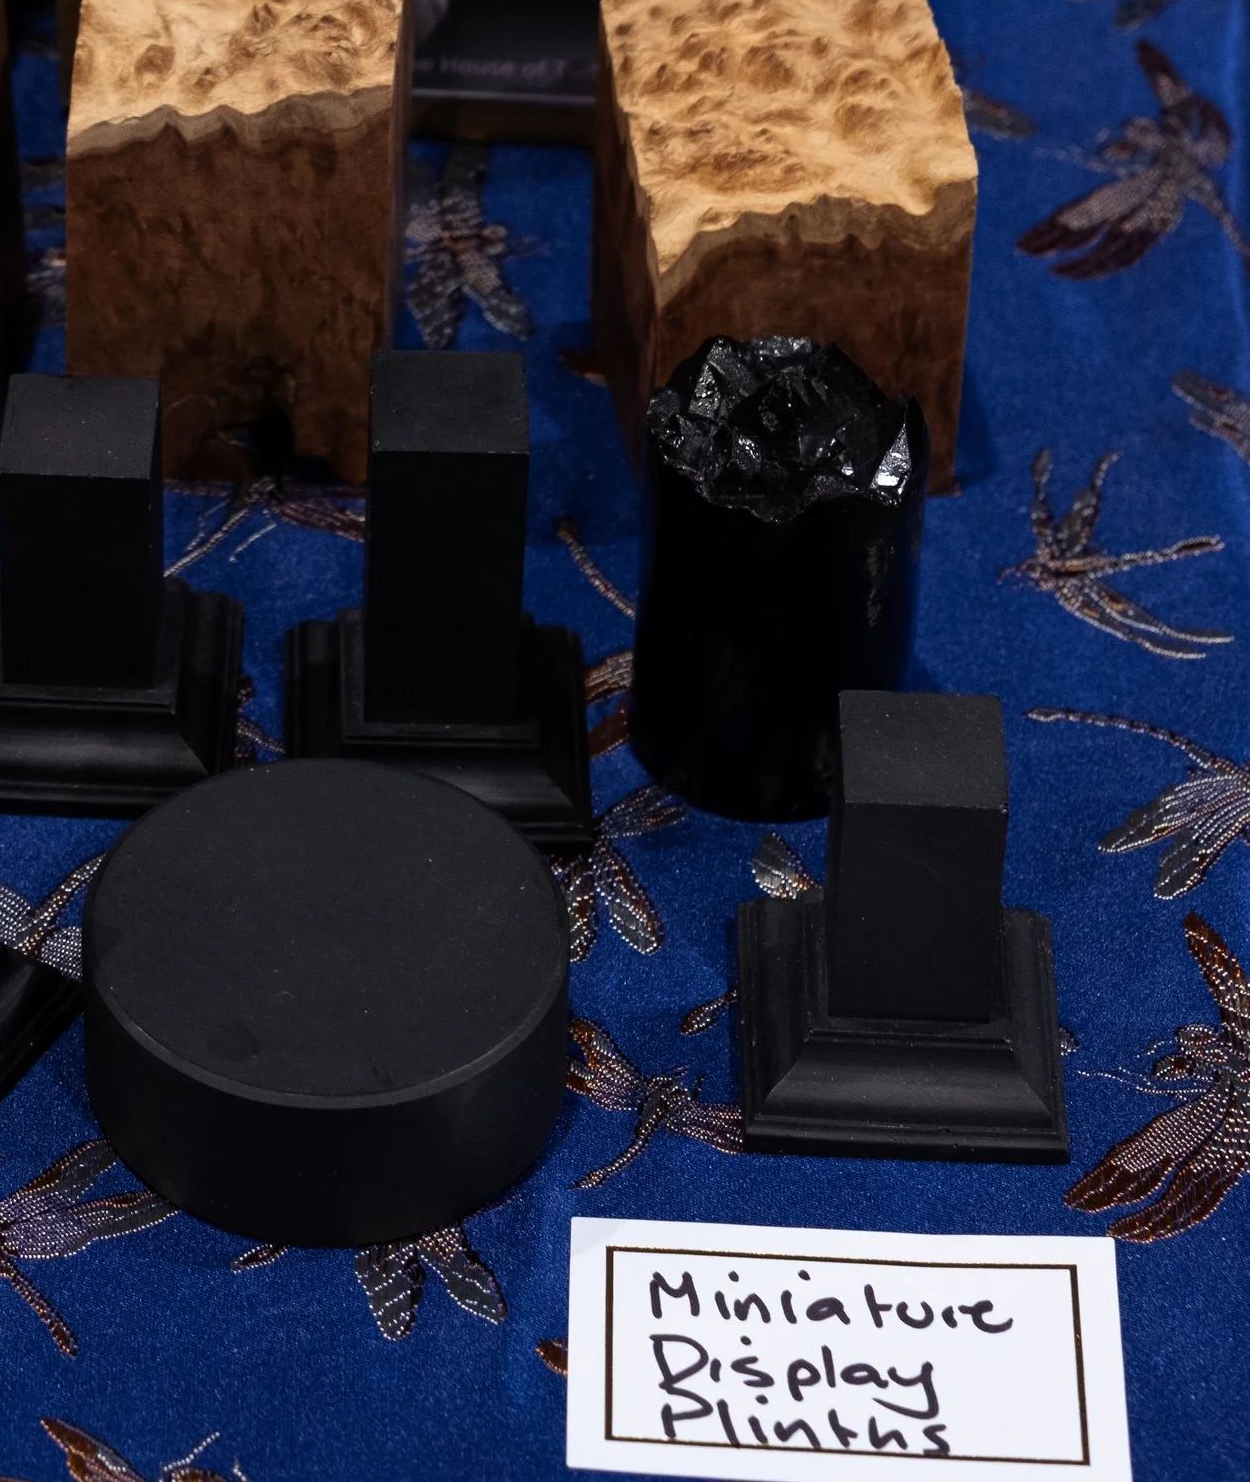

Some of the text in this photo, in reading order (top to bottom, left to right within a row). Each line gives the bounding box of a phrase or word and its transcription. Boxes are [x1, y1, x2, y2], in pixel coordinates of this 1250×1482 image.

[650, 1269, 1014, 1334] Miniature
[650, 1334, 939, 1420] Display
[660, 1385, 951, 1457] Plinths
